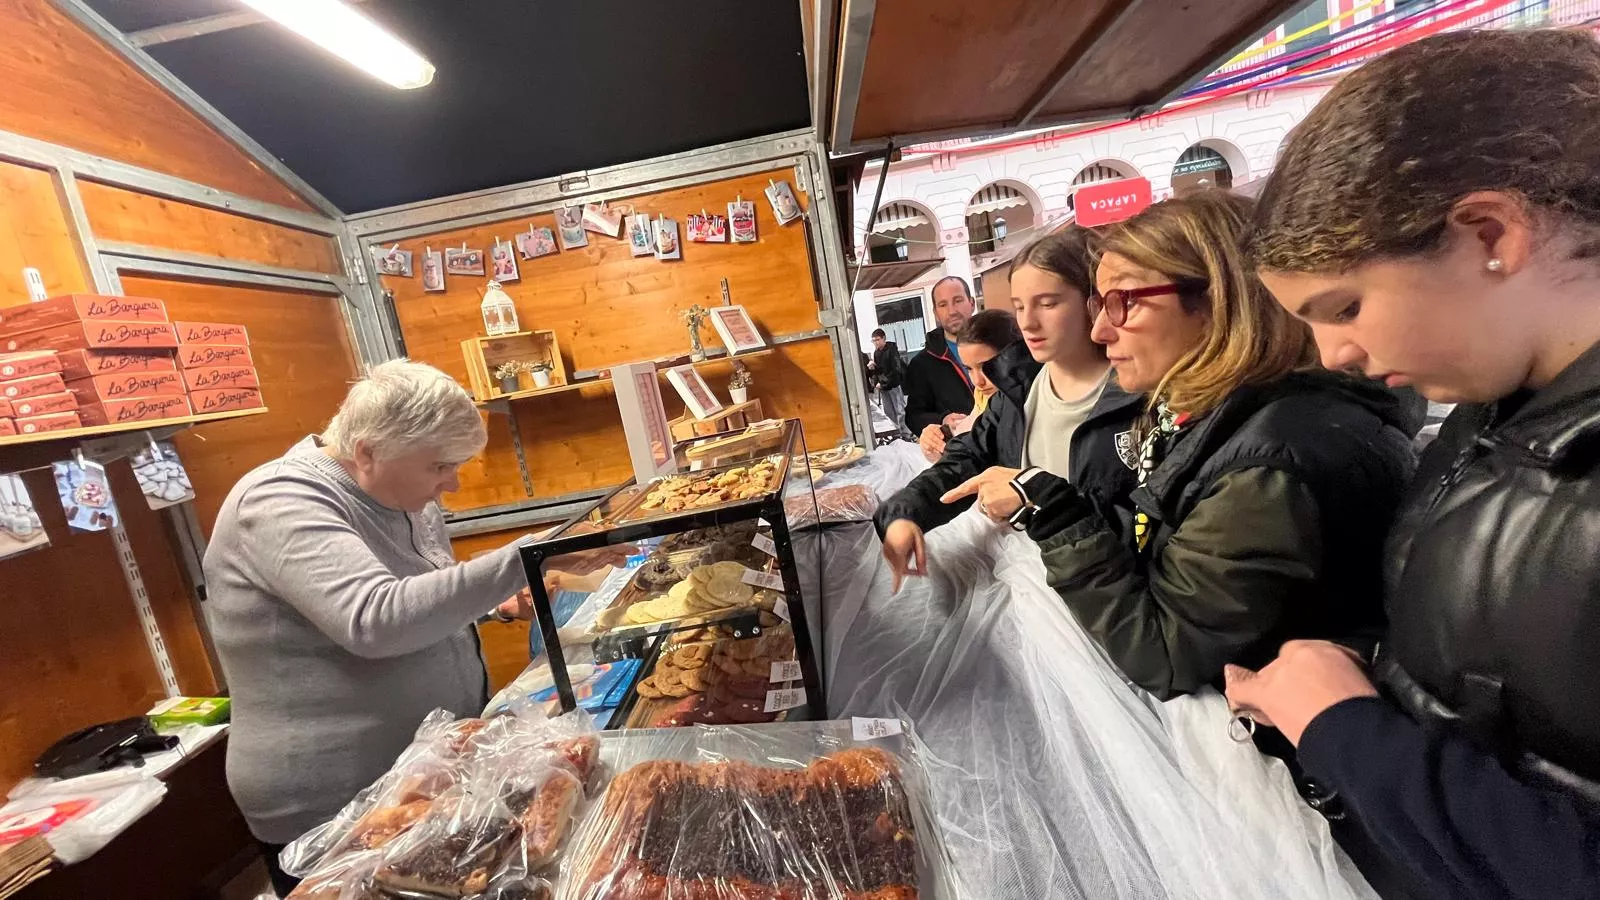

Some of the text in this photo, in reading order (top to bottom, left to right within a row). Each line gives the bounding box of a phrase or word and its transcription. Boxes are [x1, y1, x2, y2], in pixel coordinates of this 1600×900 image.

[1090, 193, 1137, 210] LAPACA
[88, 301, 106, 316] La
[106, 299, 160, 318] Barquera
[97, 328, 116, 344] La
[116, 325, 169, 344] Barquera
[187, 326, 242, 342] La Barquera
[189, 347, 245, 364] La Barquera
[107, 374, 177, 396] La Barquera
[195, 369, 252, 387] La Barquera
[117, 398, 183, 421] La Barquera
[203, 396, 217, 409] La
